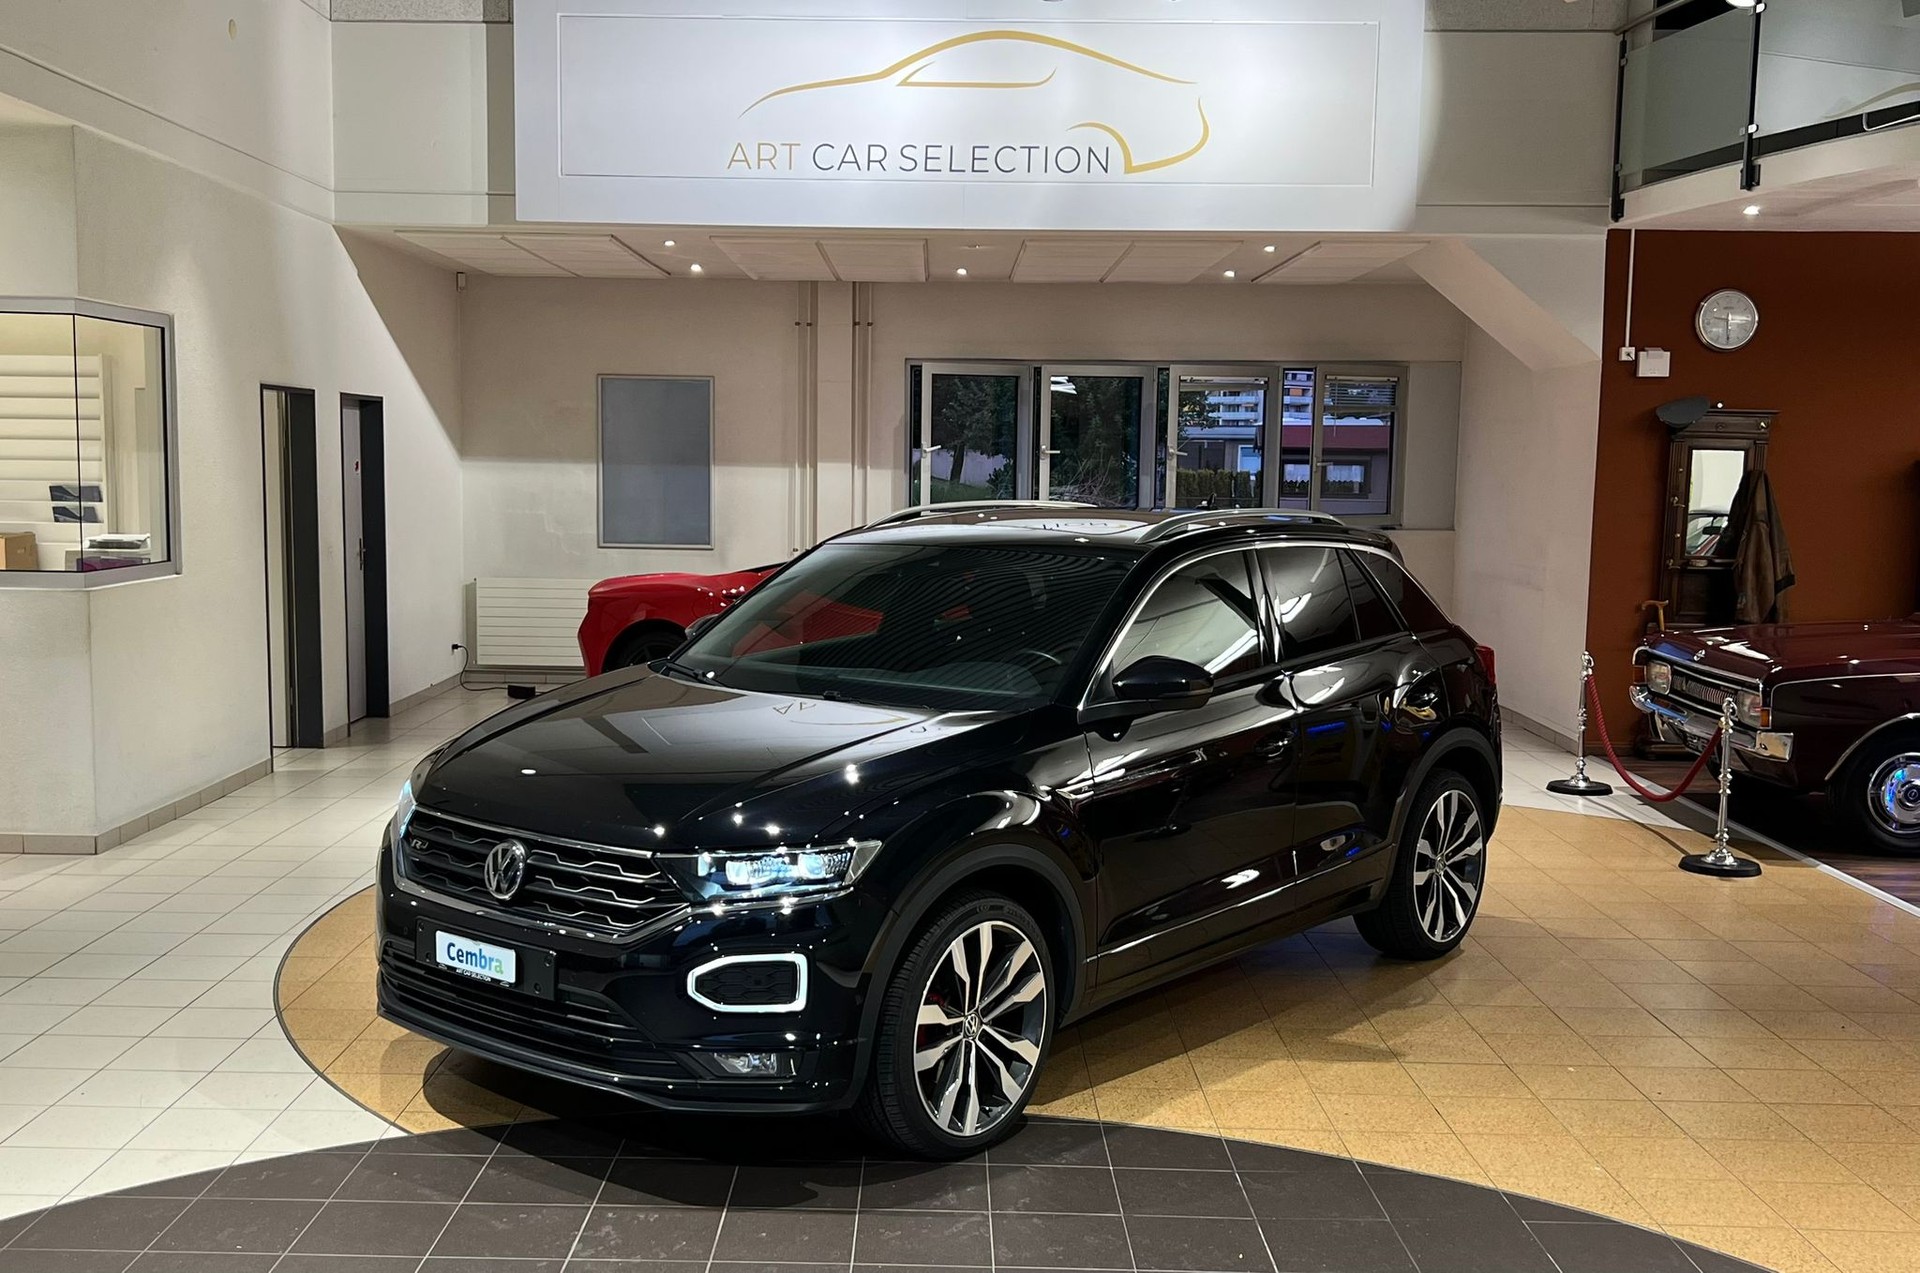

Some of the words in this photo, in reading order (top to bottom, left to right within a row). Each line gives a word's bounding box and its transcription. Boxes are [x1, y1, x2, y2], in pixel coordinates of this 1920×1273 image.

[727, 142, 801, 170] ART
[812, 143, 887, 172] CAR
[899, 144, 1109, 174] SELECTION
[446, 942, 504, 975] Cembra
